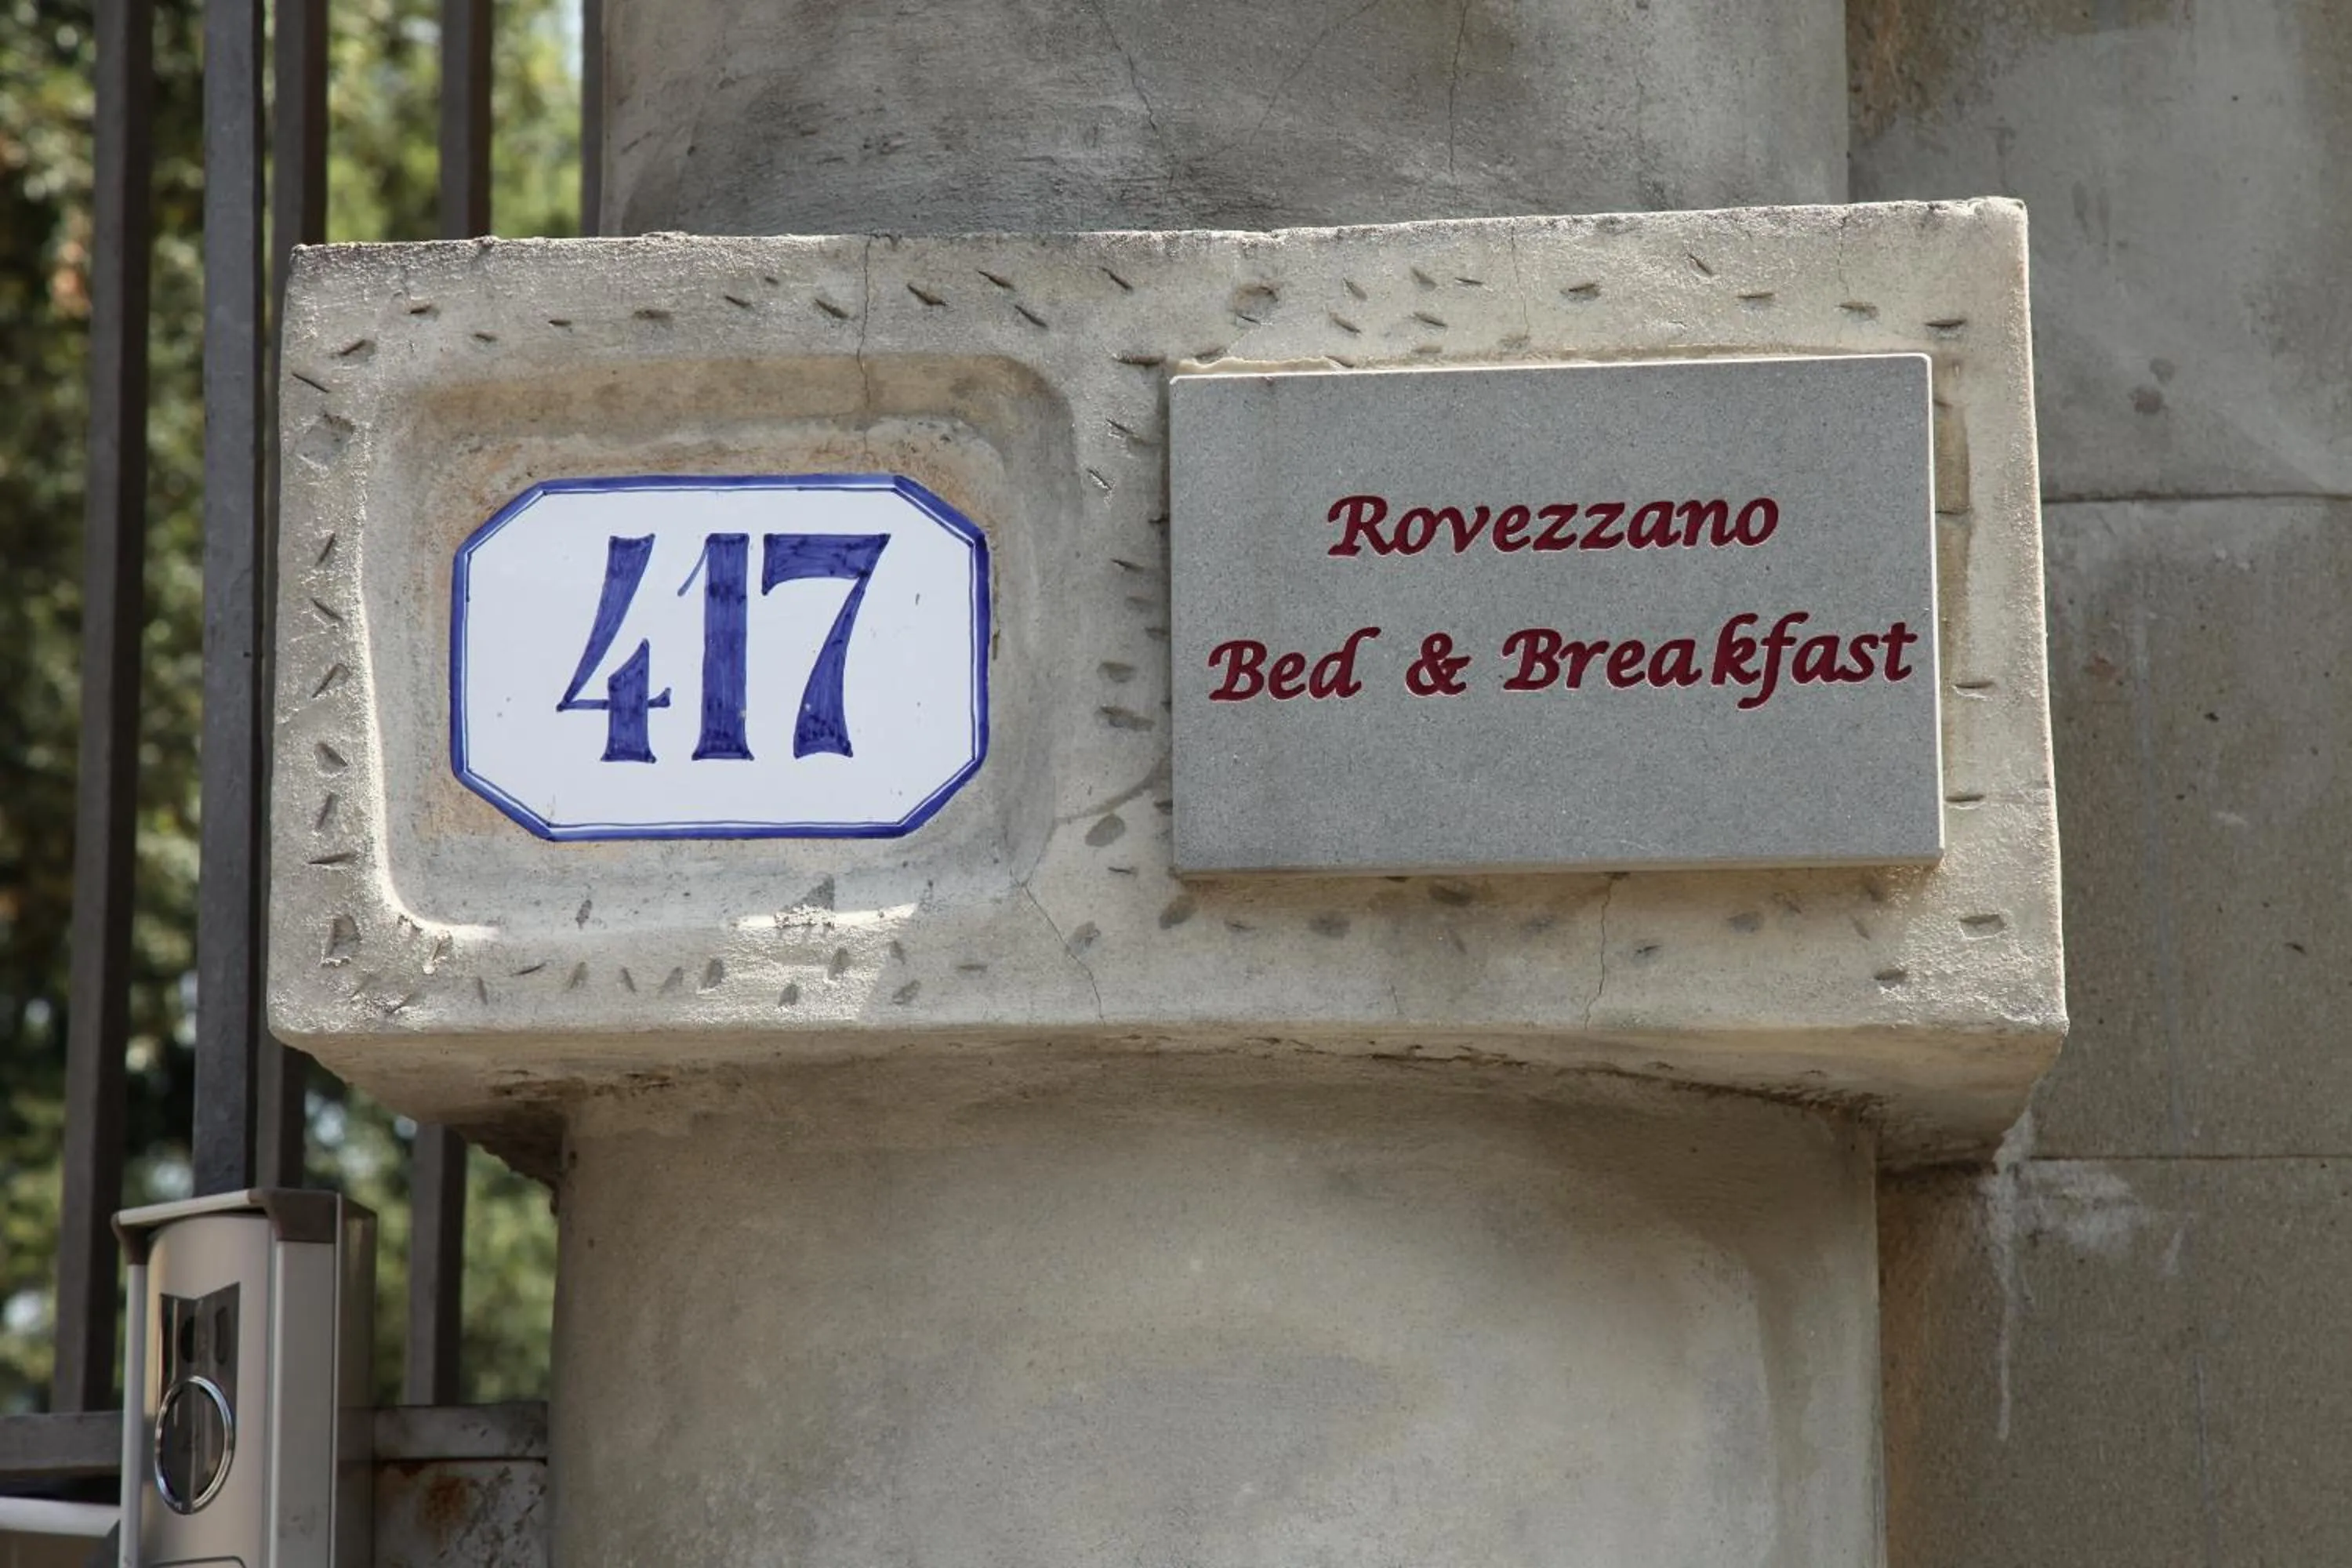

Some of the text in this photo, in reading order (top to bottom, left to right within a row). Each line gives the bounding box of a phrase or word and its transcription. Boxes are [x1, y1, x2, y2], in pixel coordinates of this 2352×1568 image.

[1328, 494, 1779, 557] Rovezzano
[556, 532, 891, 764] 417
[1207, 611, 1919, 710] Bed & Breakfast
